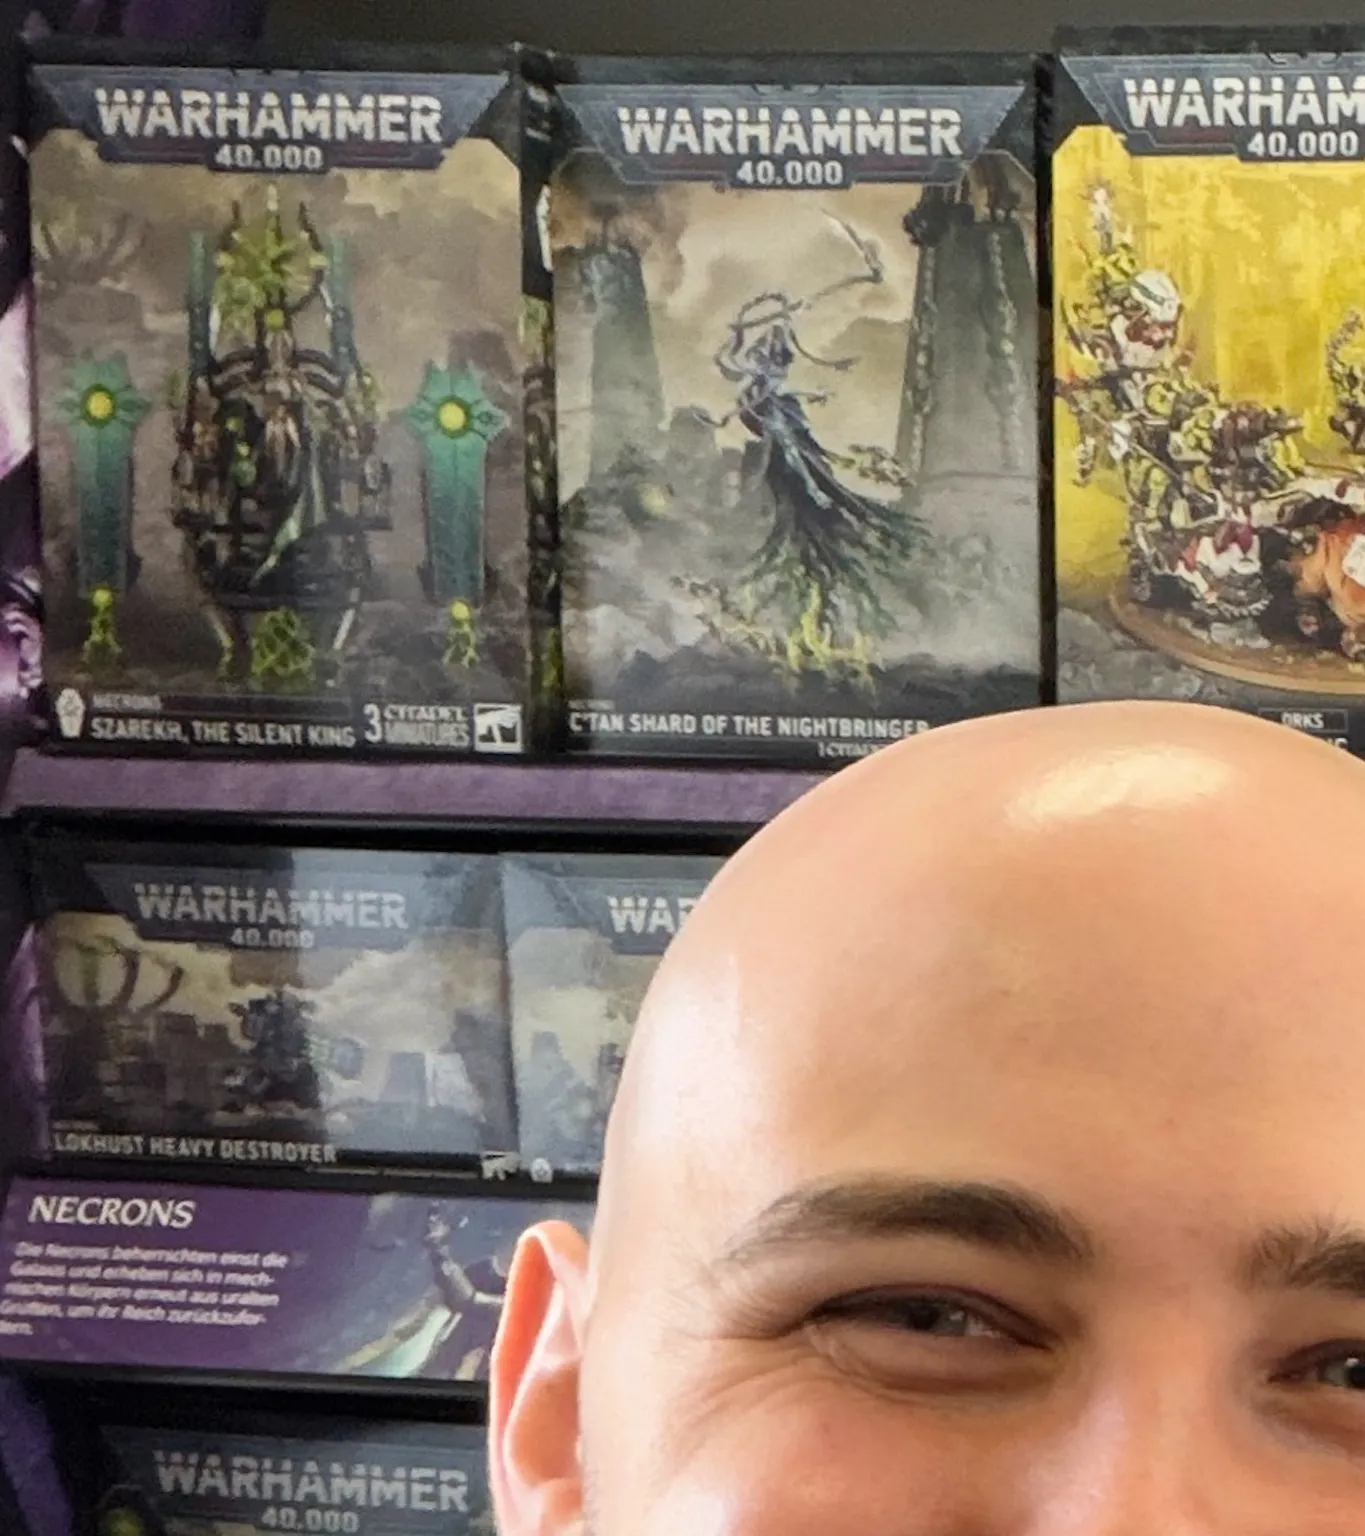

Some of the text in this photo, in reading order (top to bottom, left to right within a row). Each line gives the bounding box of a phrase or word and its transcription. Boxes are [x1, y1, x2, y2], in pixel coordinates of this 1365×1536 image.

[94, 87, 443, 144] WARHAMMER
[617, 106, 964, 156] WARHAMMER
[193, 722, 231, 745] THE
[236, 724, 302, 746] SILENT
[307, 725, 355, 748] KING
[363, 703, 382, 743] 3
[628, 714, 696, 734] SHARD
[702, 715, 727, 734] OF
[733, 716, 773, 736] THE
[1281, 712, 1325, 729] ORKS
[134, 883, 408, 929] WARHAMMER
[150, 1136, 216, 1158] HEAVY
[220, 1138, 338, 1163] DESTROYER
[28, 1195, 195, 1229] NECRONS
[152, 1450, 469, 1513] WARHAMMER
